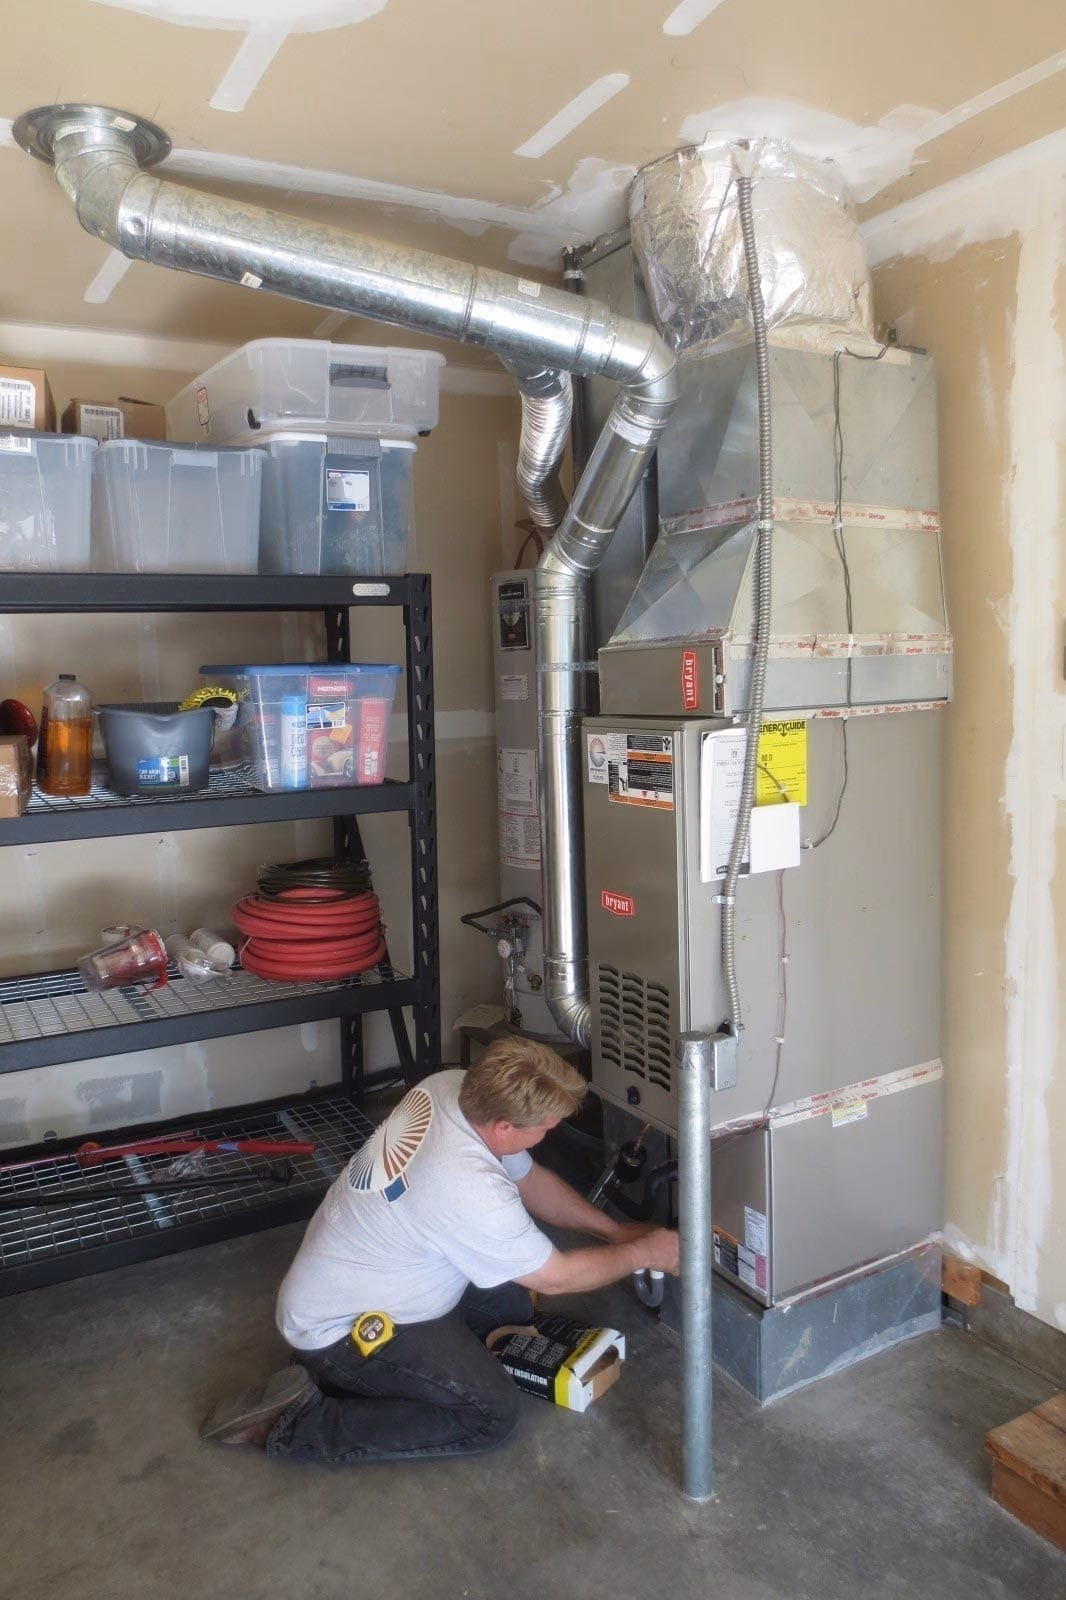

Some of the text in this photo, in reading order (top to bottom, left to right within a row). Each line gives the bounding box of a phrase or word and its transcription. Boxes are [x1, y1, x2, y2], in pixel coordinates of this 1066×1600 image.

[684, 659, 695, 702] bryant
[605, 894, 630, 912] bryant
[514, 1367, 548, 1386] INSULATION
